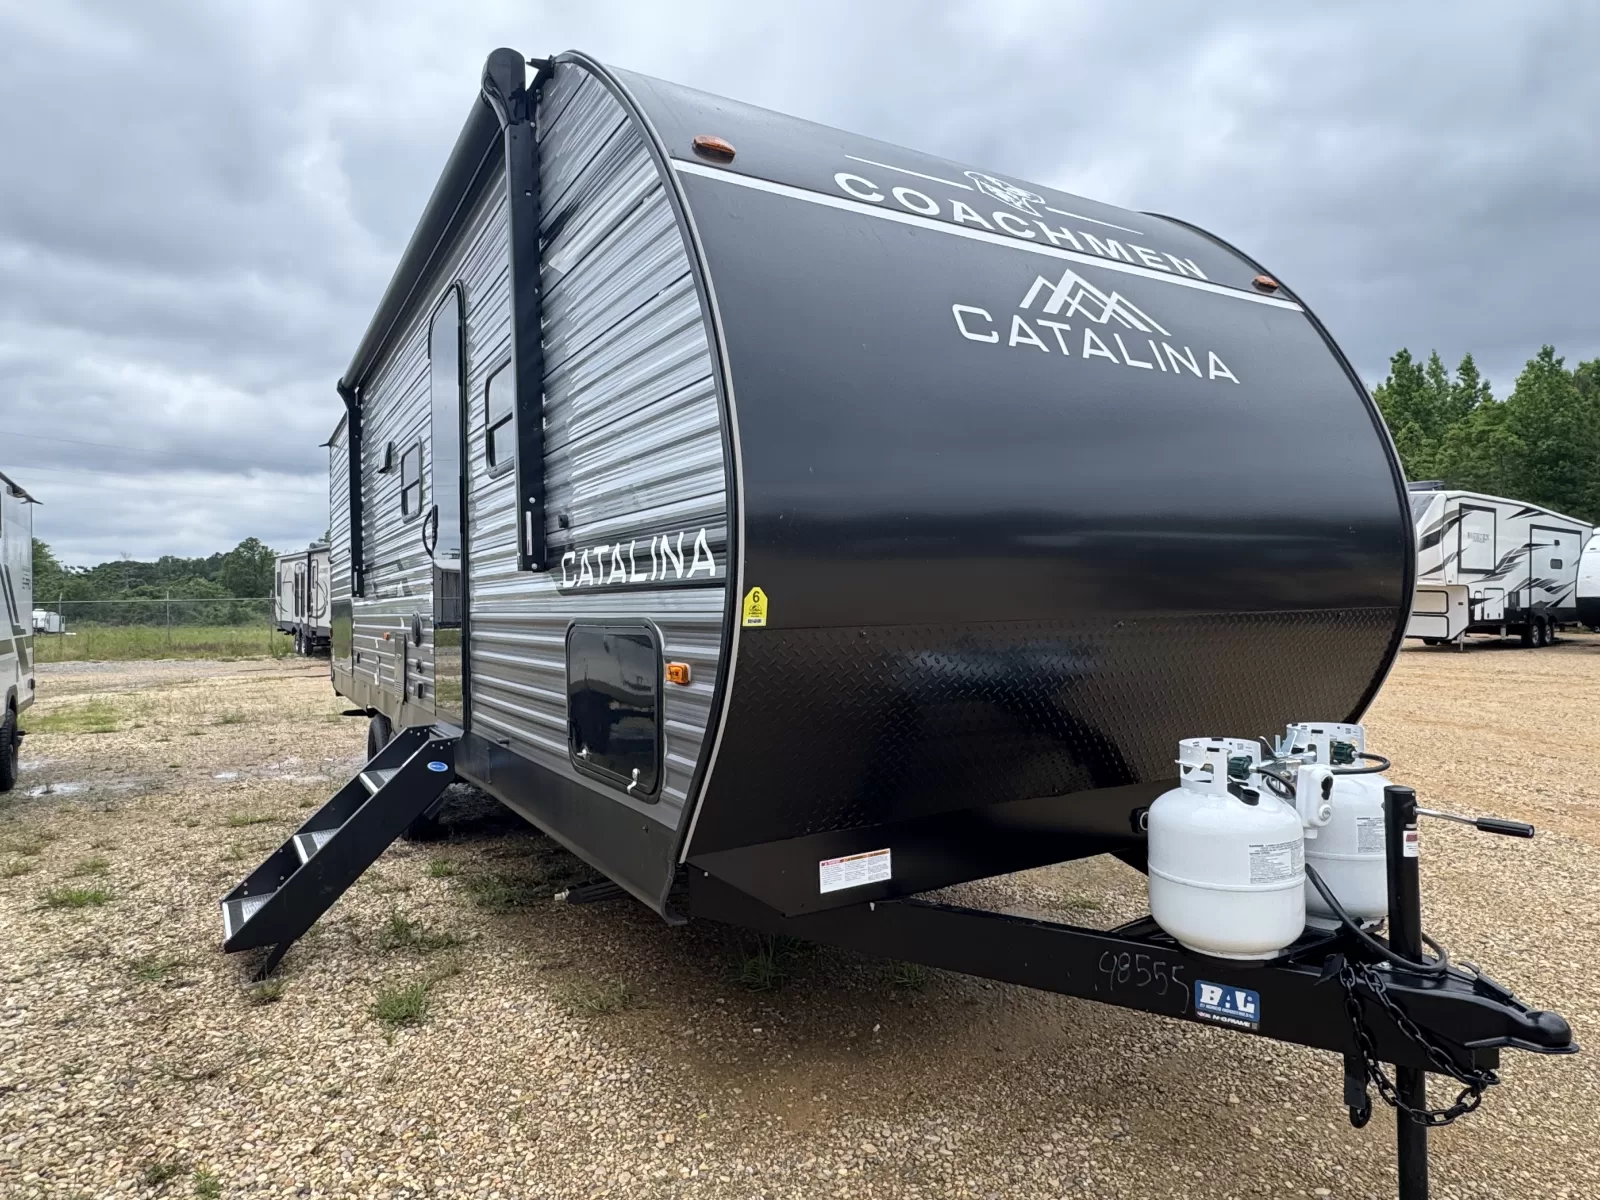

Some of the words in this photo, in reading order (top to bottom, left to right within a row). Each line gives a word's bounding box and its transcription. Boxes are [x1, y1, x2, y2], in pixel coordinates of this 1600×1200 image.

[834, 172, 1208, 281] COACHMEN
[952, 303, 1241, 385] CATALINA
[560, 527, 716, 589] CATALINA
[752, 590, 760, 603] 6
[1098, 950, 1190, 1014] 98555
